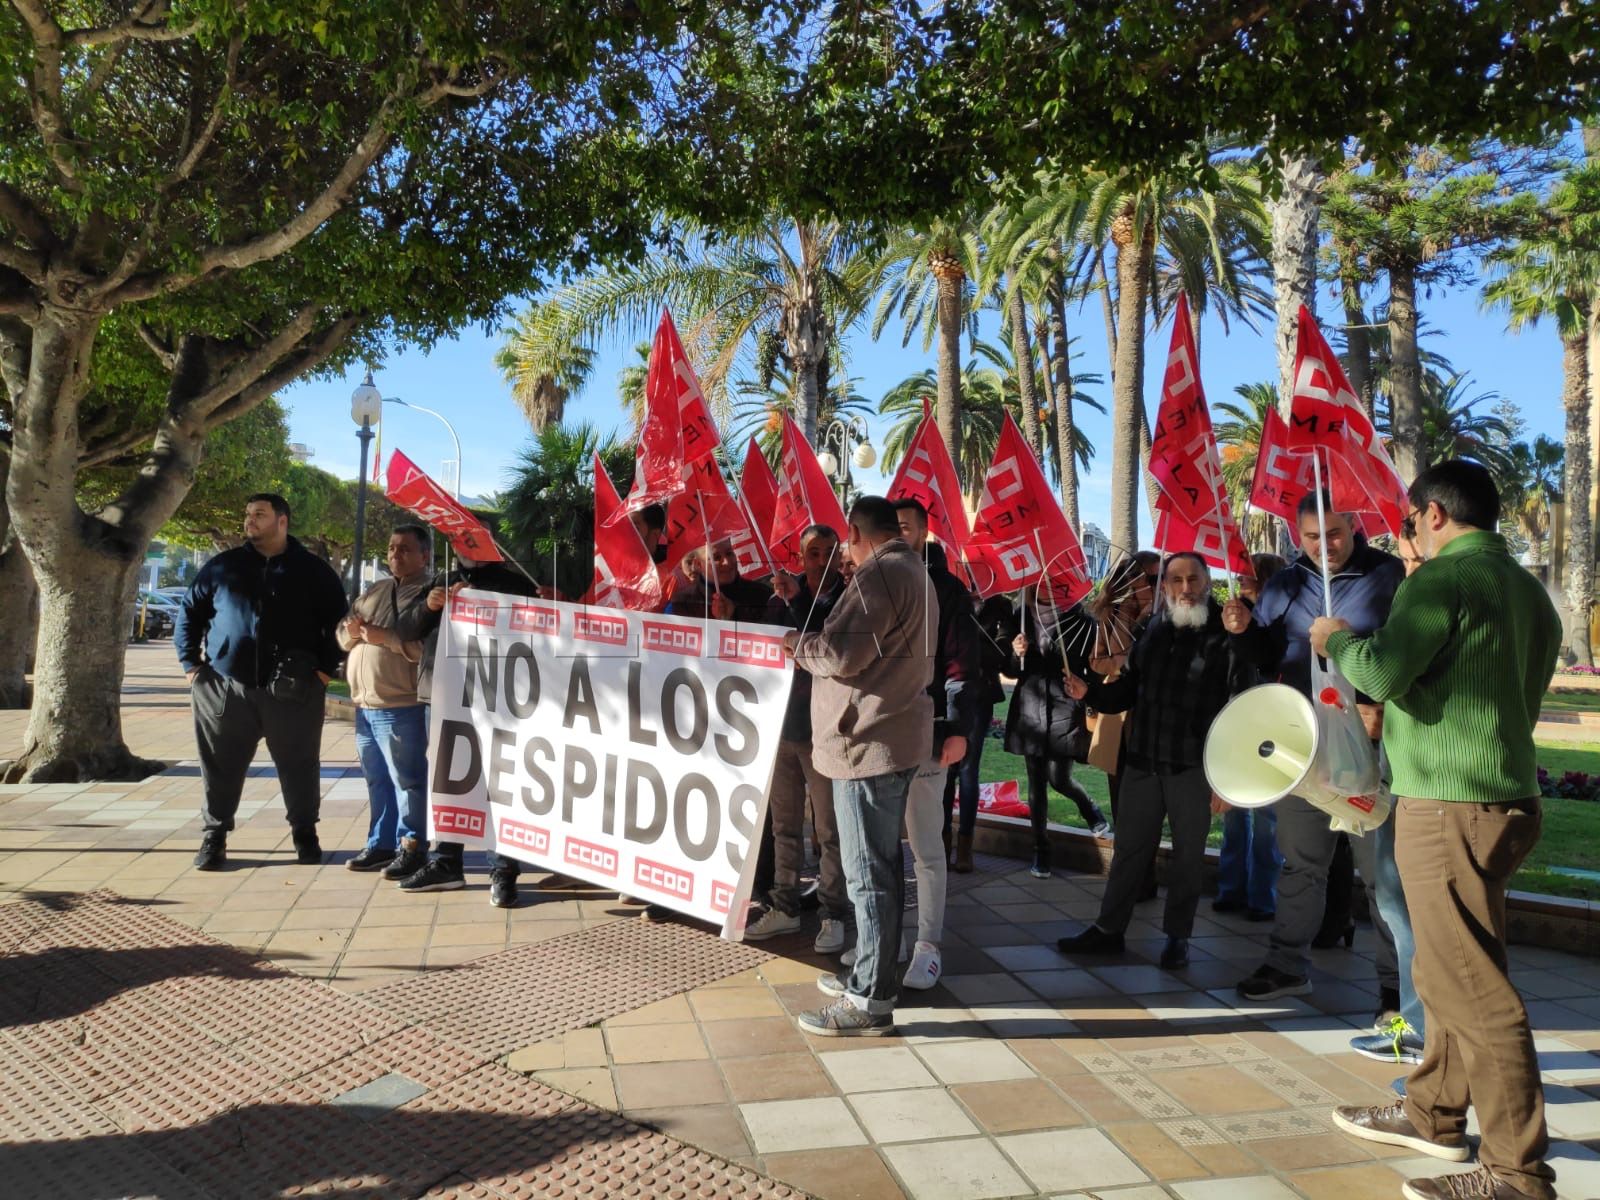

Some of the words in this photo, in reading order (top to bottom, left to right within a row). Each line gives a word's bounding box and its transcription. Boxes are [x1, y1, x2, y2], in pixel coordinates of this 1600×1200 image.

[455, 602, 494, 620] CCOO
[514, 609, 557, 629] CCOO
[577, 618, 625, 641] CCOO
[647, 627, 699, 650] CCOO
[723, 637, 781, 662] CCOO
[461, 635, 541, 720] NO
[562, 652, 602, 736] A
[627, 660, 760, 768] LOS
[432, 719, 765, 875] DESPIDOS
[502, 823, 548, 850] CCOO
[567, 842, 616, 871] CCOO
[637, 863, 691, 895] CCOO
